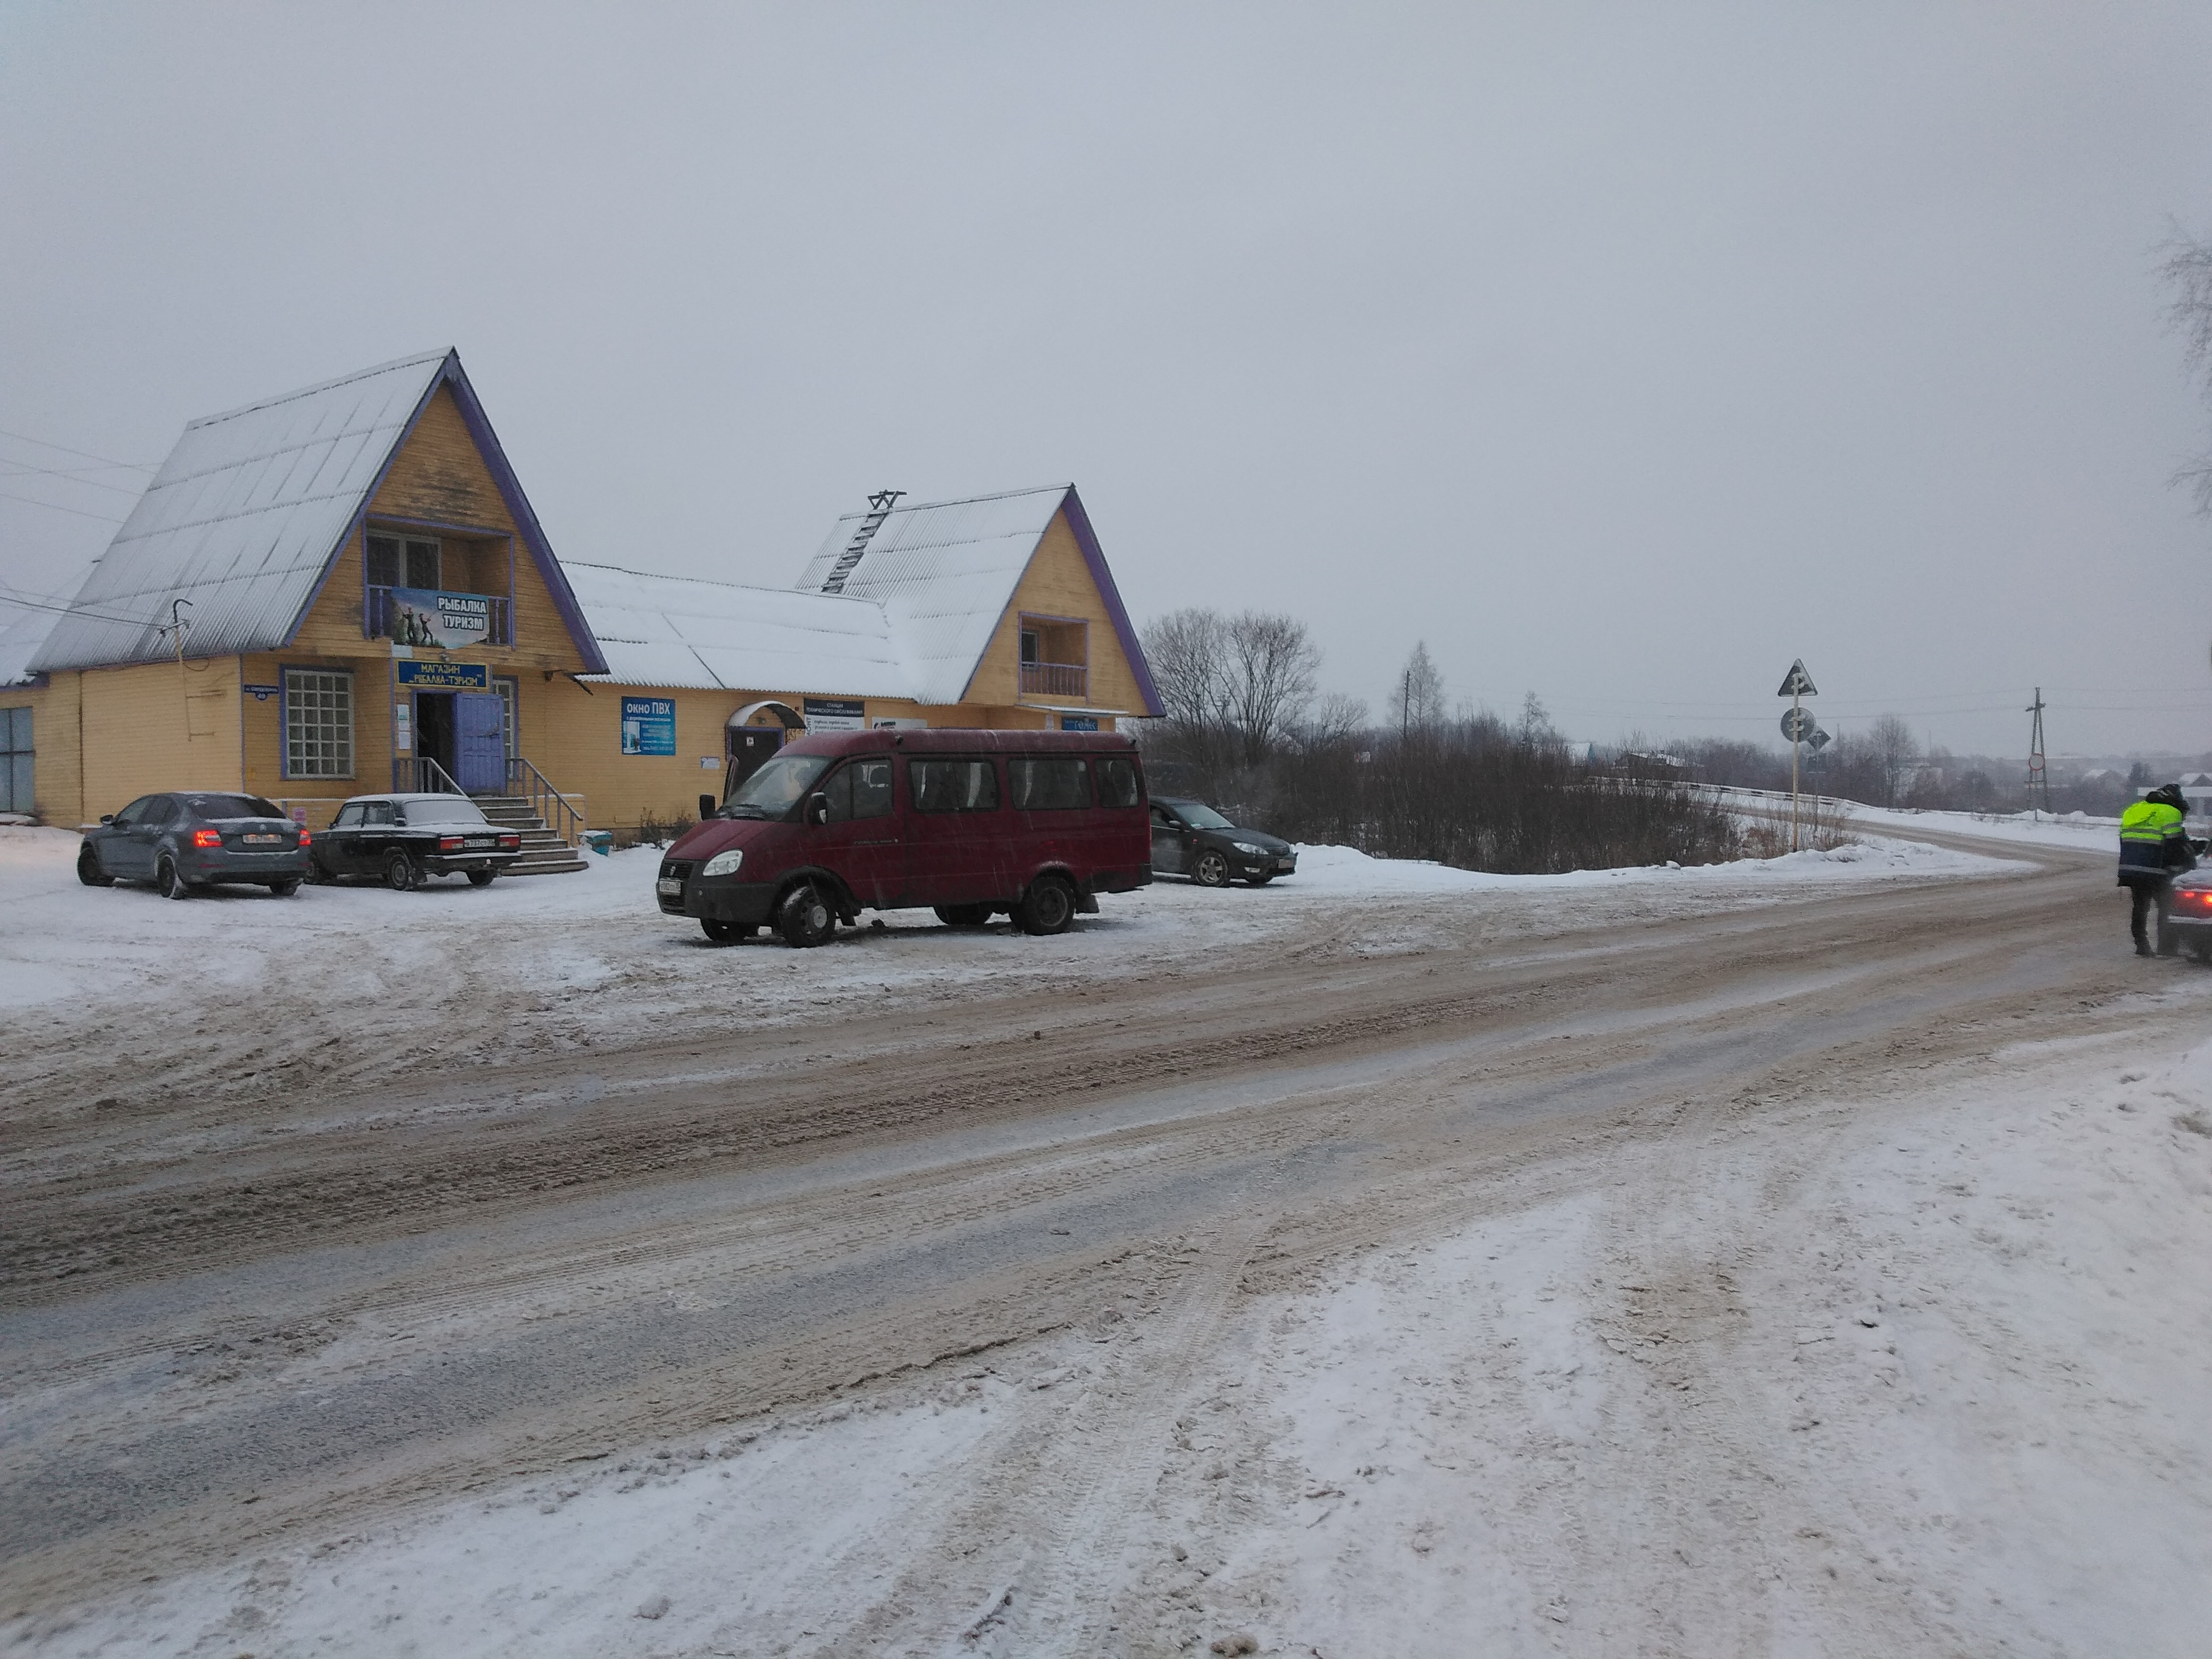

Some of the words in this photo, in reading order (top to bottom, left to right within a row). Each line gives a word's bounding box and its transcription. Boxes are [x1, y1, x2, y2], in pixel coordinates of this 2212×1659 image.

[438, 597, 487, 614] РЫБАЛКА
[443, 615, 483, 630] ТУРИЗМ
[421, 664, 460, 674] МАГАЗИН
[652, 701, 671, 715] ПВХ
